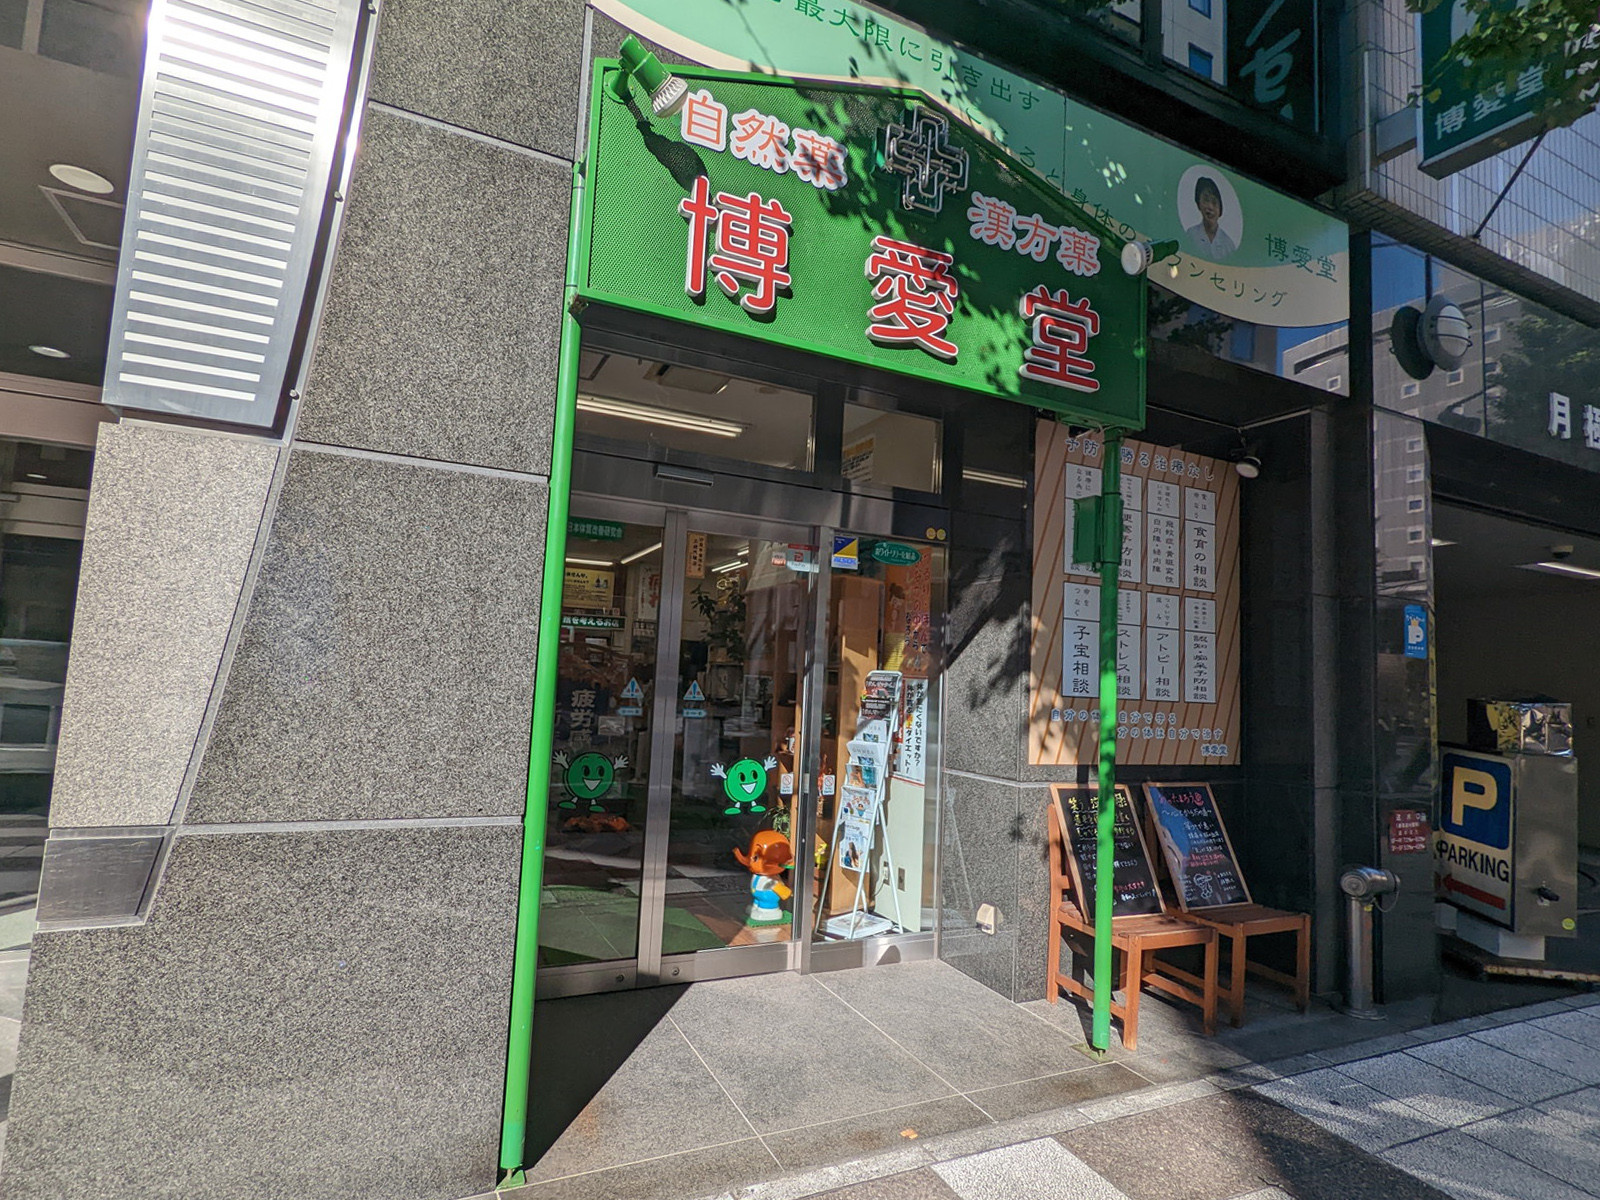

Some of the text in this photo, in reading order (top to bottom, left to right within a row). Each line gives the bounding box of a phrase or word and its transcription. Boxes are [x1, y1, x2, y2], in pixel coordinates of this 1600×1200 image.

[772, 0, 1040, 110] 最大限に引き出す
[1434, 62, 1550, 140] 博愛堂
[683, 91, 848, 189] 自然薬
[968, 192, 1100, 275] 漢方薬
[1265, 233, 1338, 282] 博愛堂
[679, 175, 1100, 393] 博愛堂
[1065, 438, 1214, 481] 予防勝る治療なし
[1193, 527, 1208, 588] 食育の相談
[1073, 625, 1090, 694] 子宝相談
[1117, 629, 1131, 696] ストレス相談
[1155, 633, 1171, 698] アトピー相談
[1051, 709, 1176, 724] 自分の体自分で守る
[1117, 725, 1223, 741] 分の体は自分で治す
[1201, 744, 1228, 756] 博愛堂
[1452, 766, 1498, 826] P
[1439, 840, 1510, 884] PARKING
